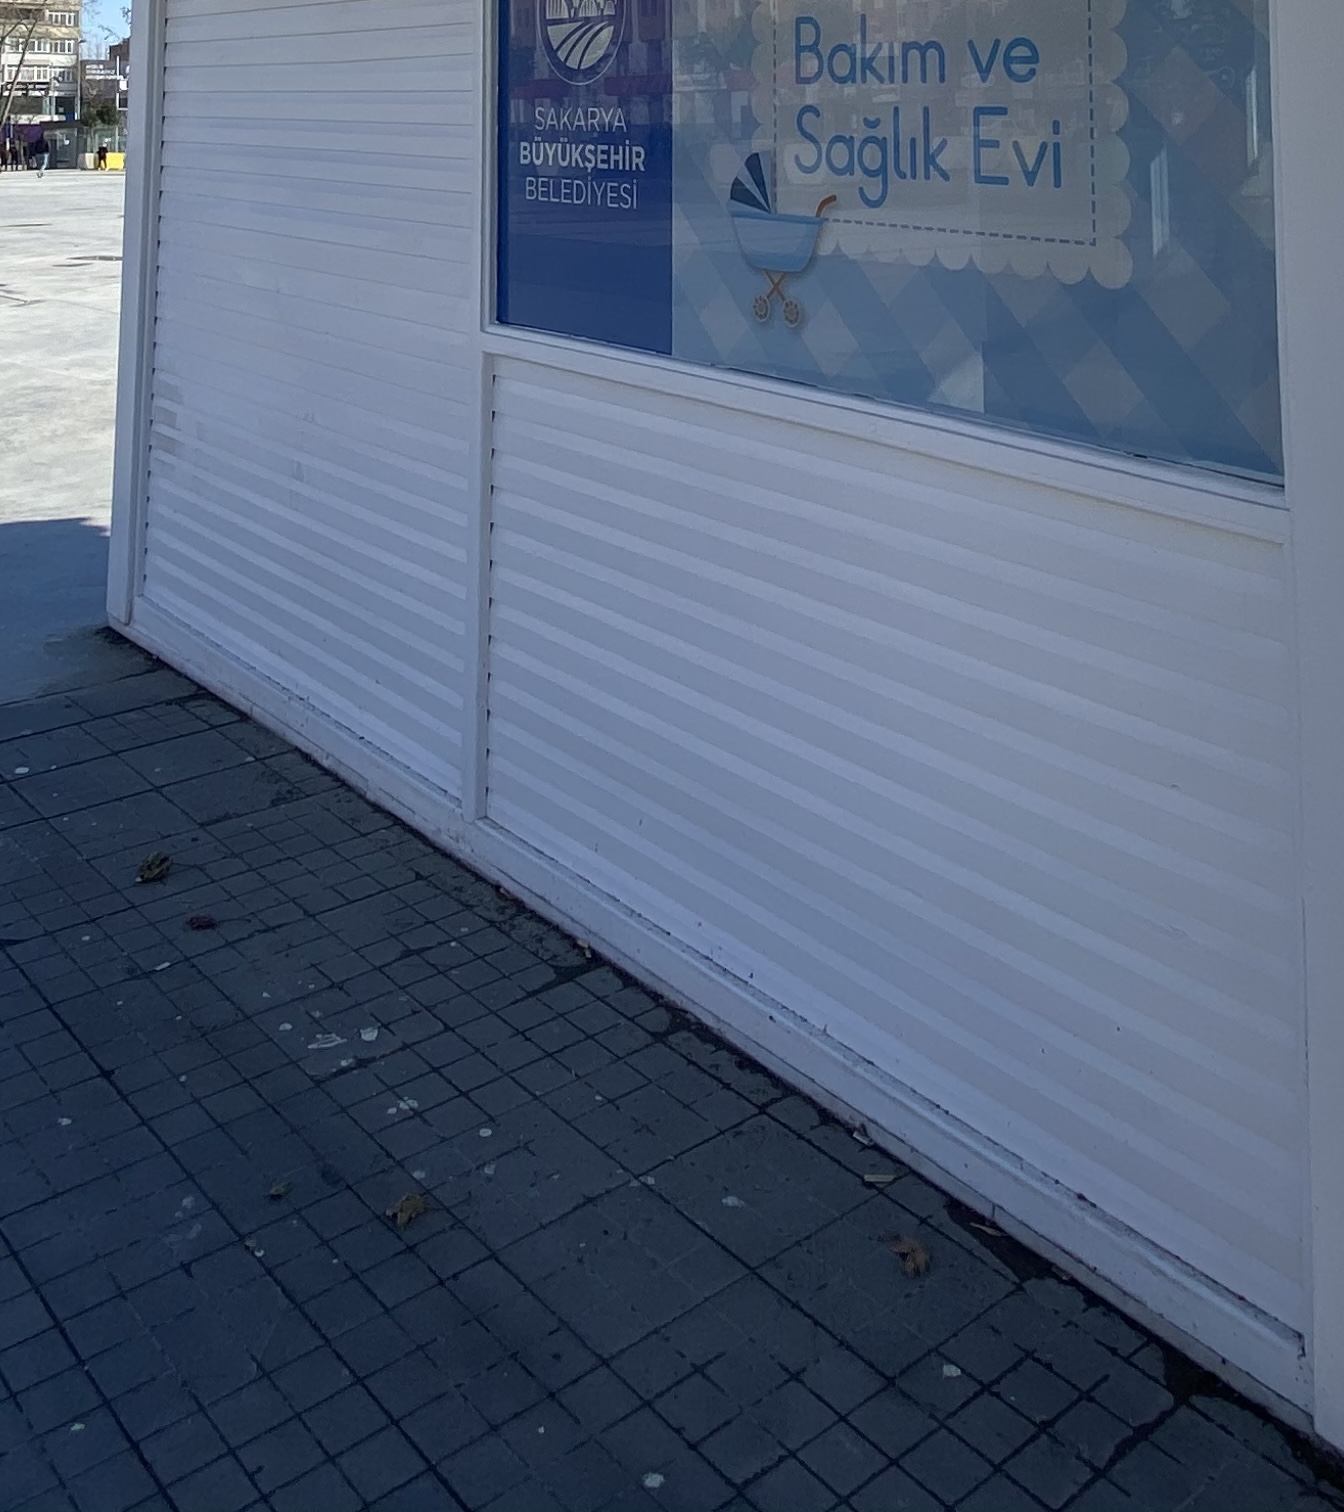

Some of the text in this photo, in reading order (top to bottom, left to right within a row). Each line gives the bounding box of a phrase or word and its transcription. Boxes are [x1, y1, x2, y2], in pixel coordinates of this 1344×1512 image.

[794, 14, 1041, 87] Bakım ve
[534, 106, 627, 133] SAKARYA
[519, 136, 645, 172] BÜYÜKŞEHİR
[793, 105, 1063, 209] Sağlık Evi
[525, 175, 638, 209] BELEDİYESİ
